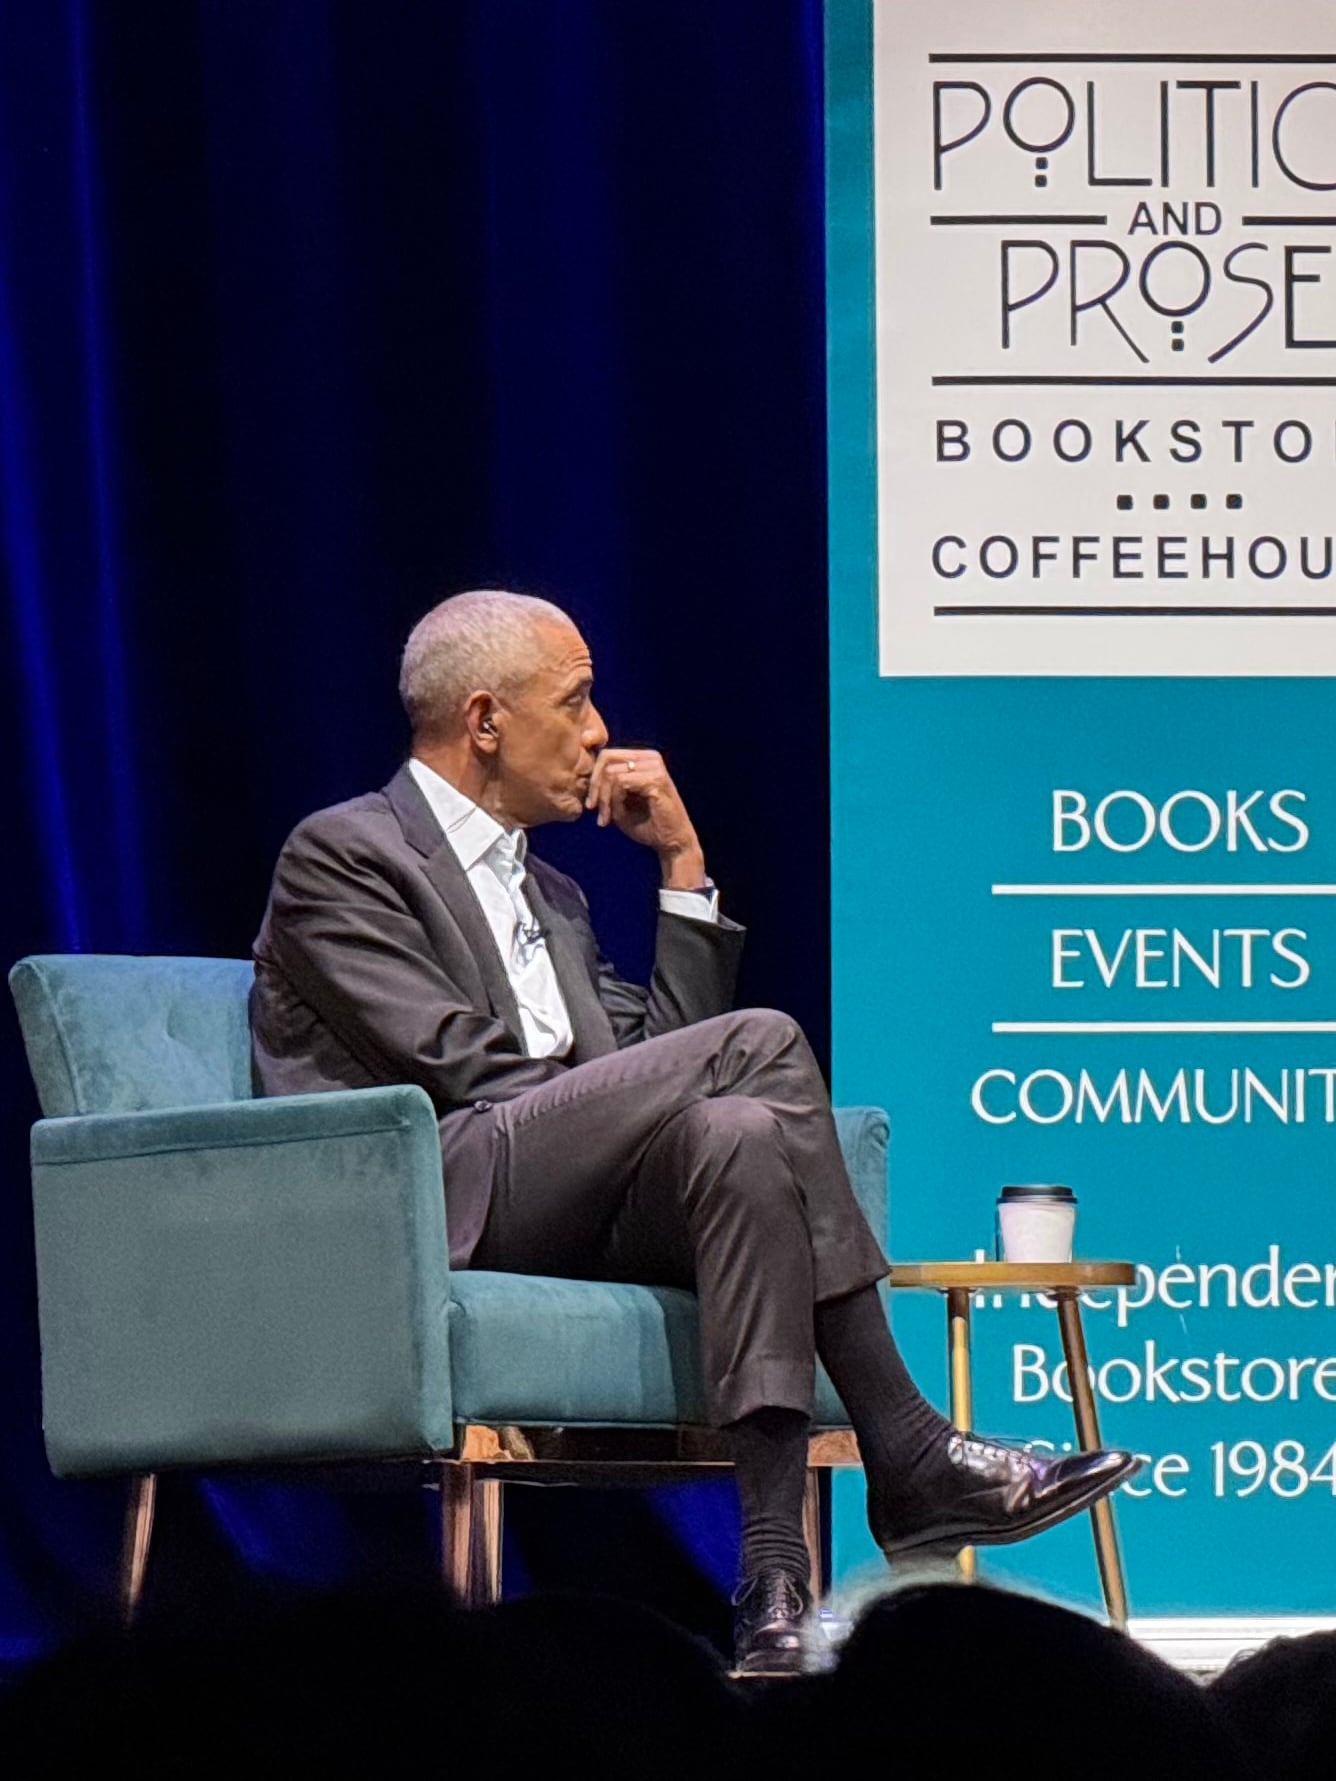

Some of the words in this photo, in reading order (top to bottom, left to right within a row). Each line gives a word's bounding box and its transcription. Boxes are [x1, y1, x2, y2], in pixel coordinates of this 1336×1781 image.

[1128, 201, 1222, 236] AND
[1053, 789, 1309, 852] BOOKS
[1052, 928, 1310, 988] EVENTS
